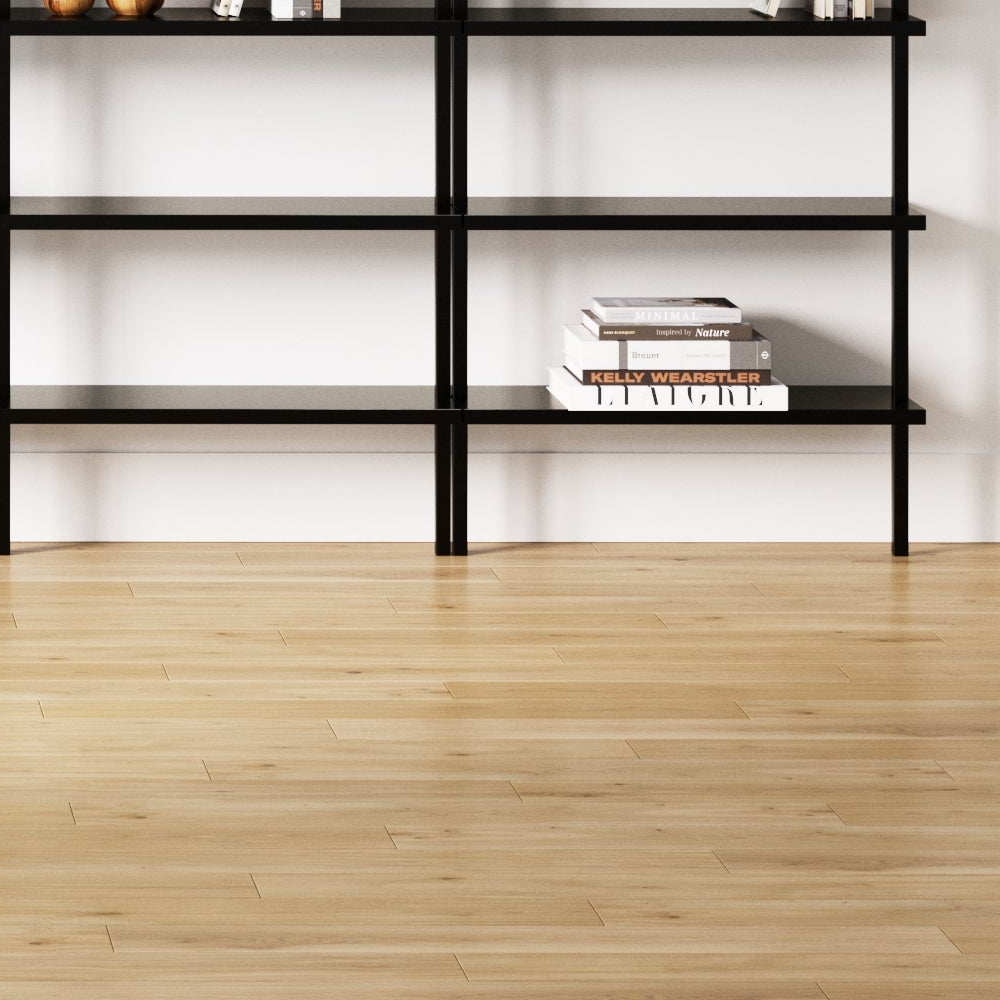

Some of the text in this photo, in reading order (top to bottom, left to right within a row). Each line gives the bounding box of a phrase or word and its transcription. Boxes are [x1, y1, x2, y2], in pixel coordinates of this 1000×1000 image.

[634, 311, 699, 321] MINIMAL
[656, 328, 730, 338] Inspired by Nature
[632, 351, 660, 359] Breuer
[591, 372, 760, 384] KELLY WEARSTLER
